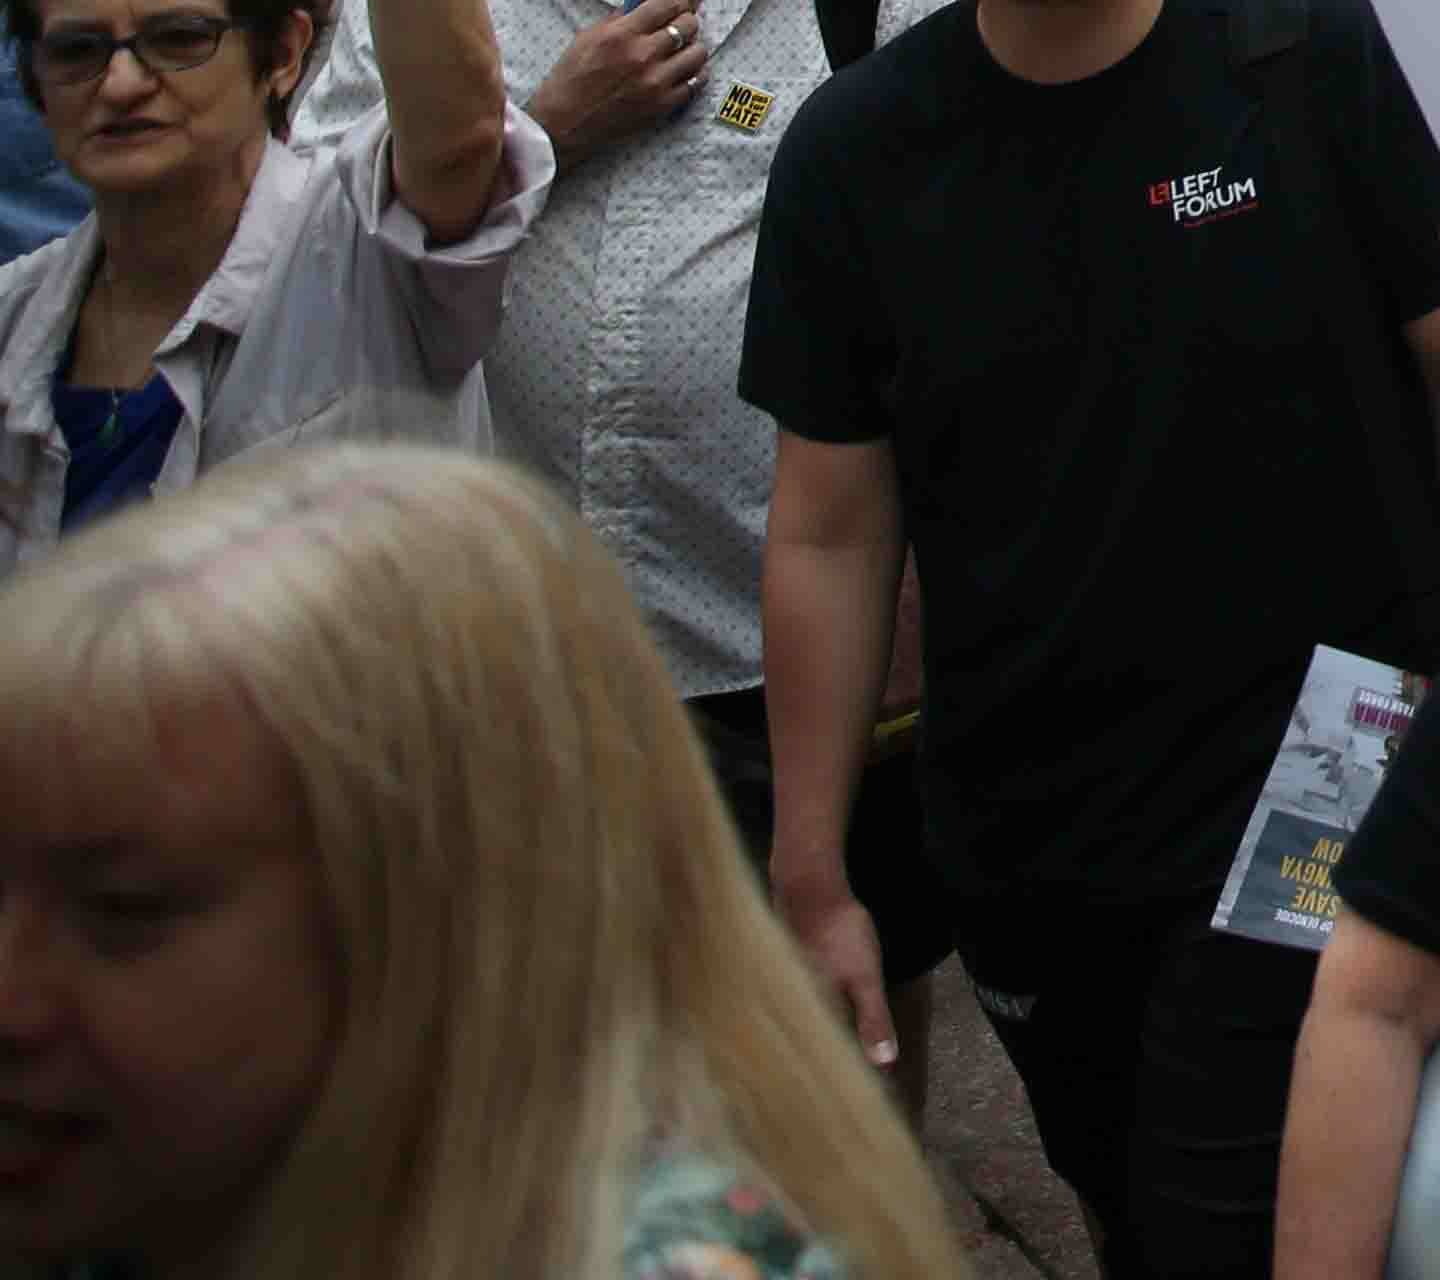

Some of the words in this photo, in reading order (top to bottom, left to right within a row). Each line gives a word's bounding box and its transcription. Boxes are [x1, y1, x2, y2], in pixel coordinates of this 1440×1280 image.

[720, 102, 761, 129] HATE
[1170, 166, 1223, 201] LEFT
[1173, 177, 1257, 222] FORUM
[1311, 837, 1344, 864] OW
[1293, 887, 1342, 917] SAVE
